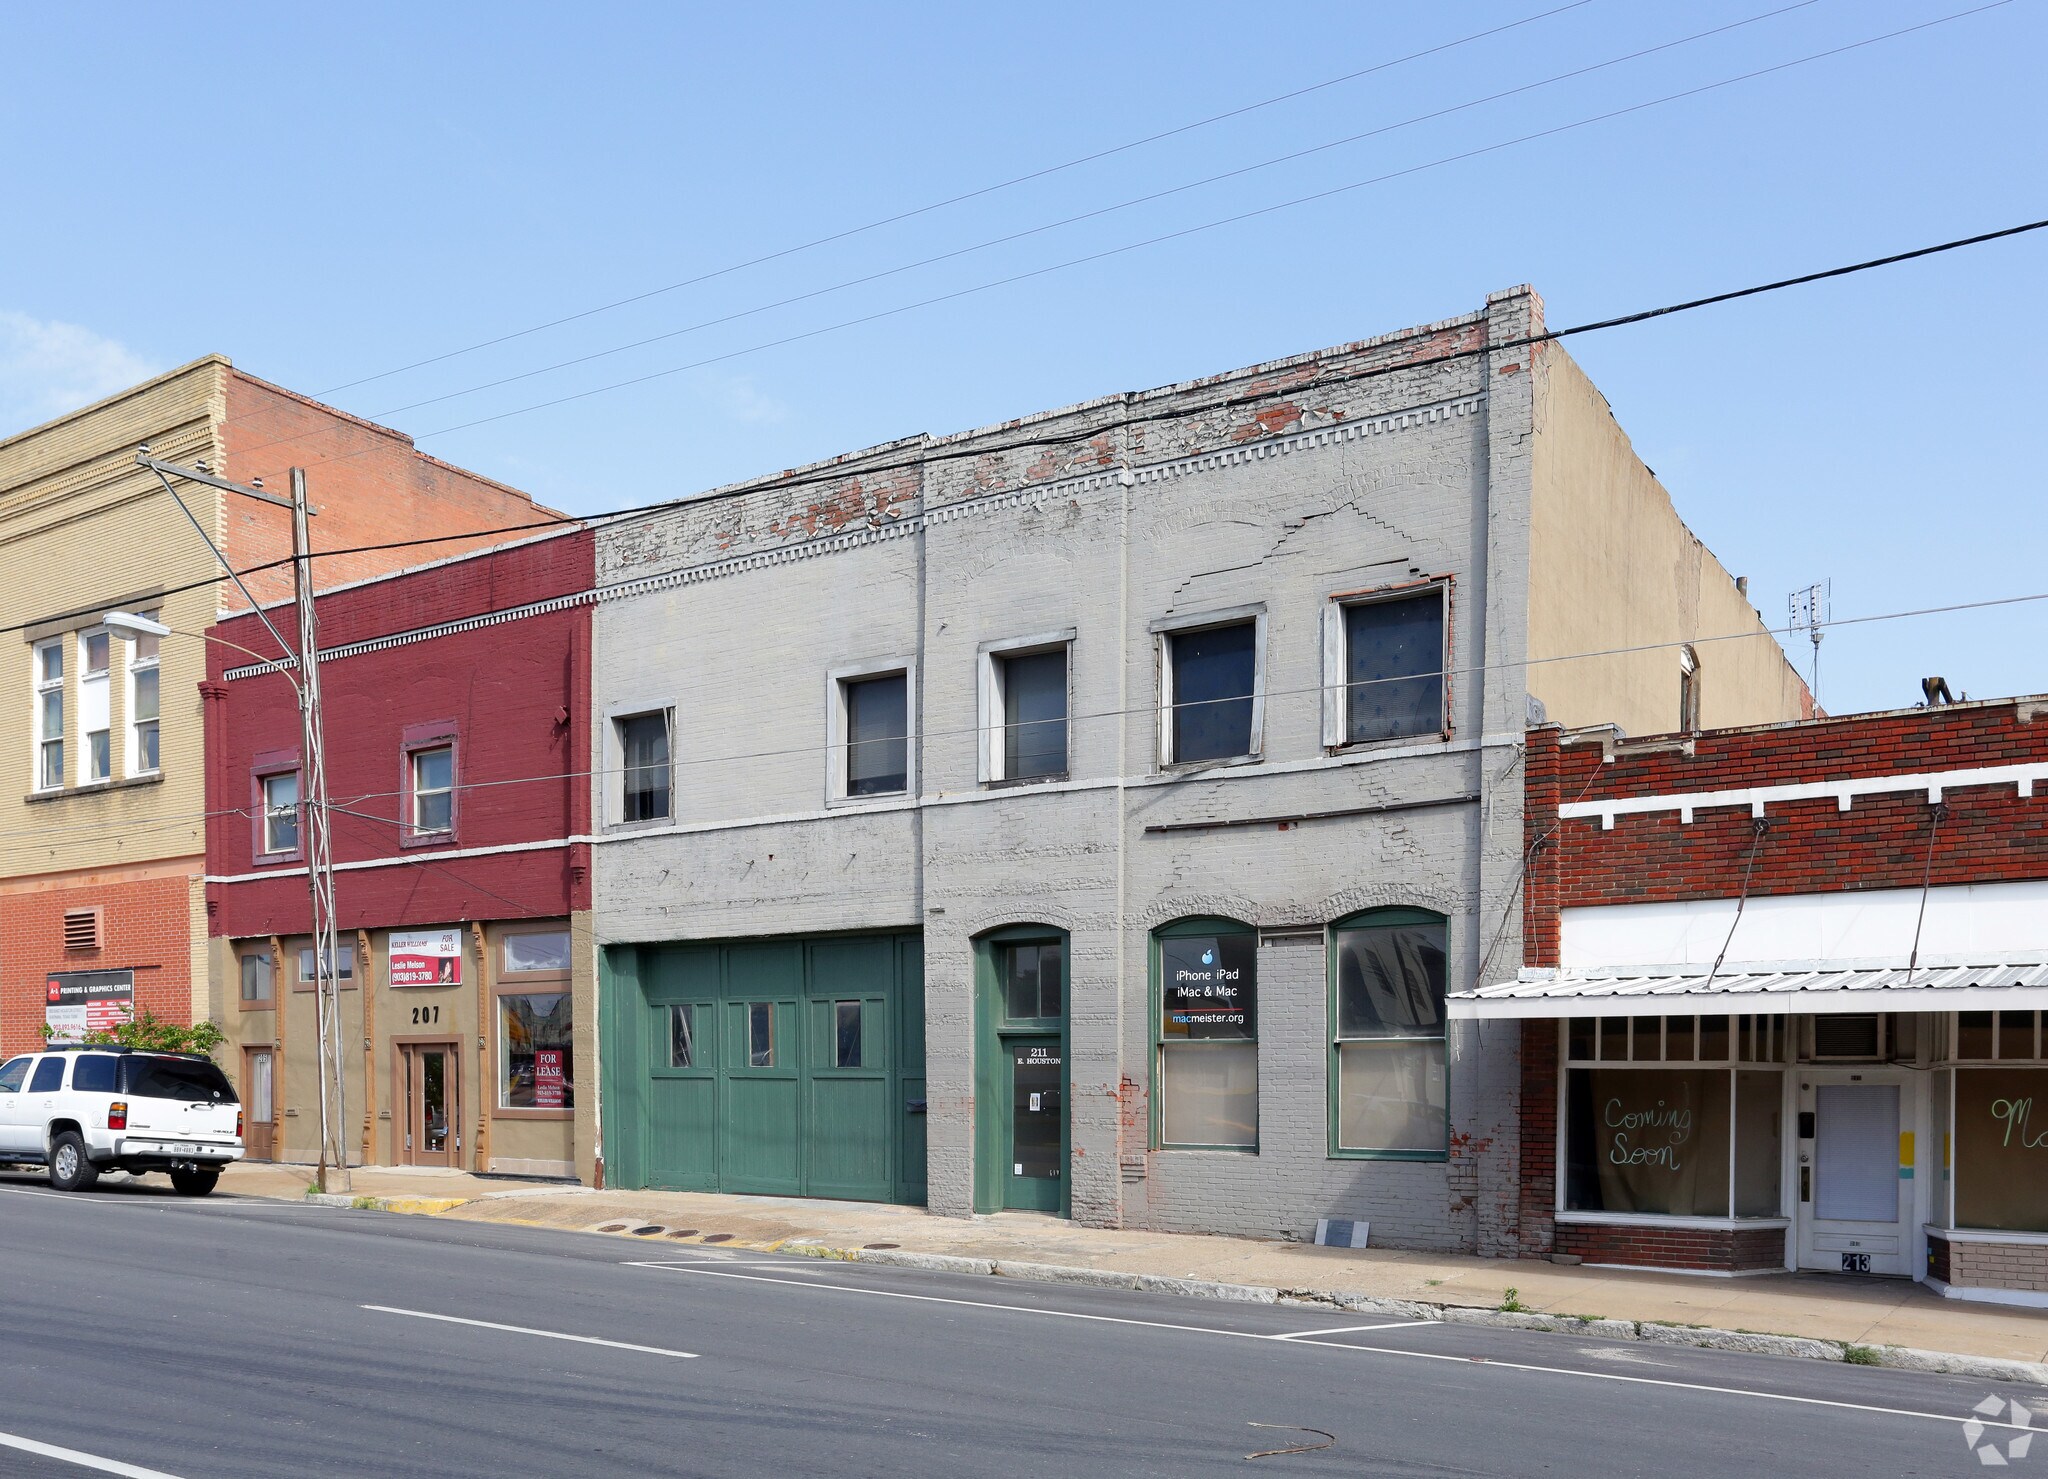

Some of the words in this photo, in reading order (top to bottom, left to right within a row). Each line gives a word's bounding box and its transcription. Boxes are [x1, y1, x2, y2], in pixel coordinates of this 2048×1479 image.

[440, 944, 454, 952] SALE
[392, 962, 406, 970] Leslie
[1176, 970, 1211, 981] iPhone
[1216, 968, 1239, 980] iPad
[60, 986, 82, 994] PRINTING
[1177, 986, 1201, 997] iMac
[1204, 986, 1212, 997] &
[1216, 986, 1238, 997] Mac
[412, 1006, 439, 1024] 207
[1172, 1013, 1244, 1024] macmeister.org
[1030, 1047, 1047, 1057] 211
[540, 1054, 556, 1064] FOR
[536, 1067, 561, 1077] LEASE
[1605, 1098, 1691, 1145] Coming
[1610, 1132, 1681, 1171] Soon
[1843, 1254, 1870, 1272] 213
